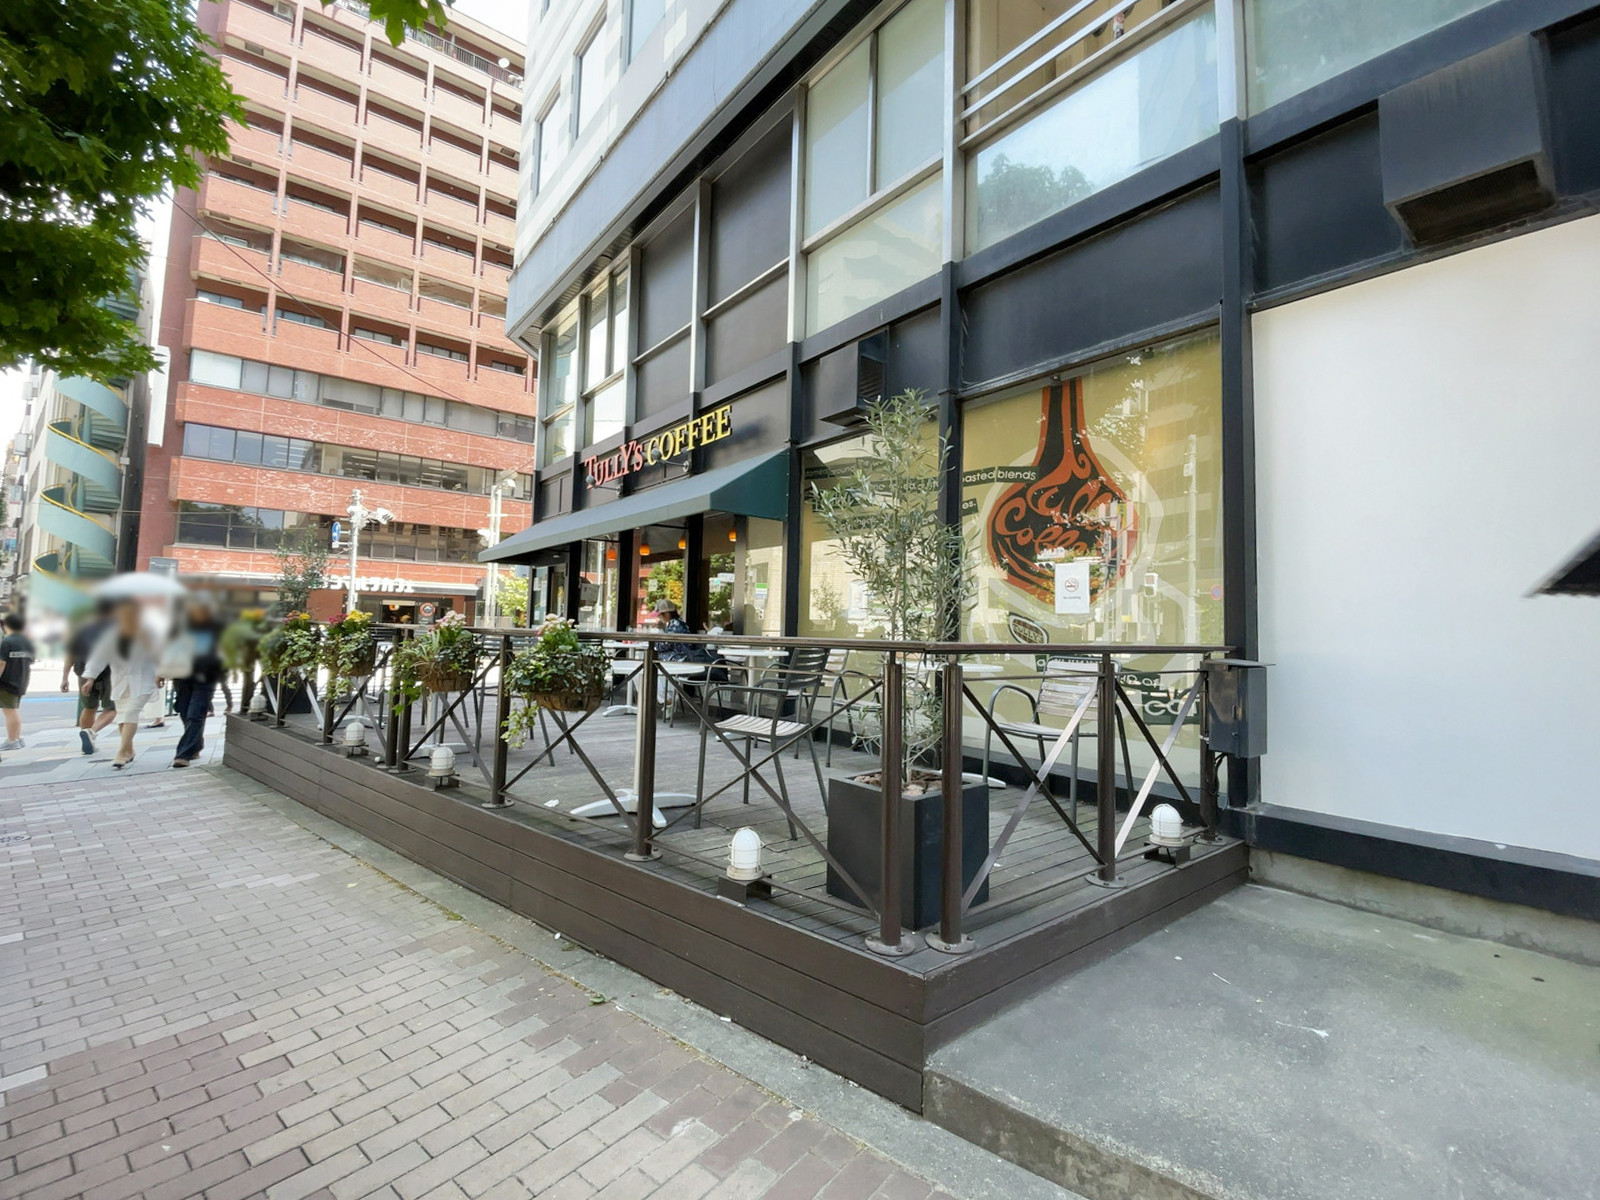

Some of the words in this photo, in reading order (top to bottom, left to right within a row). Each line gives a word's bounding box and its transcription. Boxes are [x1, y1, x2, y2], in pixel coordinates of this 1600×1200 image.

[584, 440, 644, 490] TULLY'S
[646, 404, 732, 466] COFFEE
[997, 470, 1036, 481] blends
